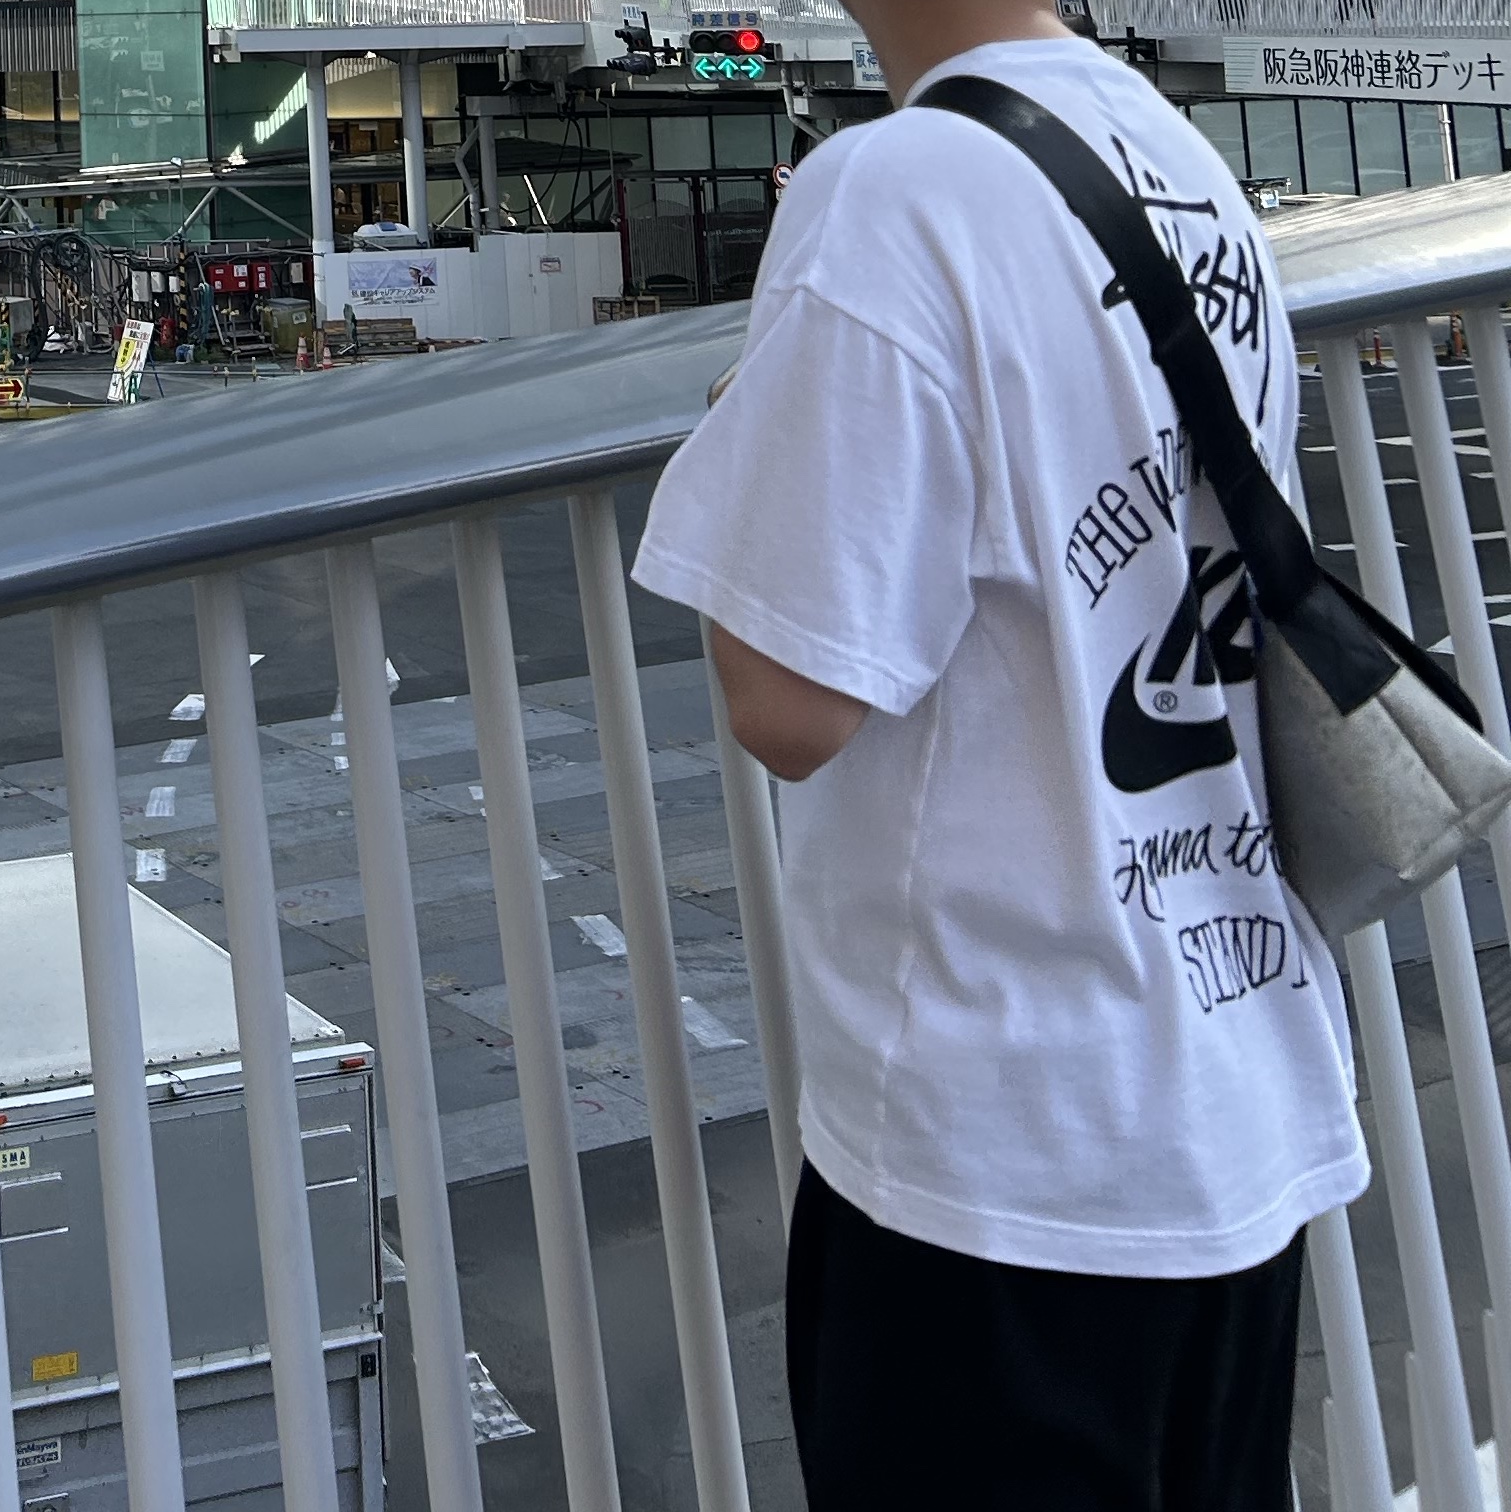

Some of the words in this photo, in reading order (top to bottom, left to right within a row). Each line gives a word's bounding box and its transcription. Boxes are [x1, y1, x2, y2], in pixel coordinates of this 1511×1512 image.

[691, 12, 759, 27] 時差信号
[1262, 46, 1505, 92] 阪急阪神連絡デッキ
